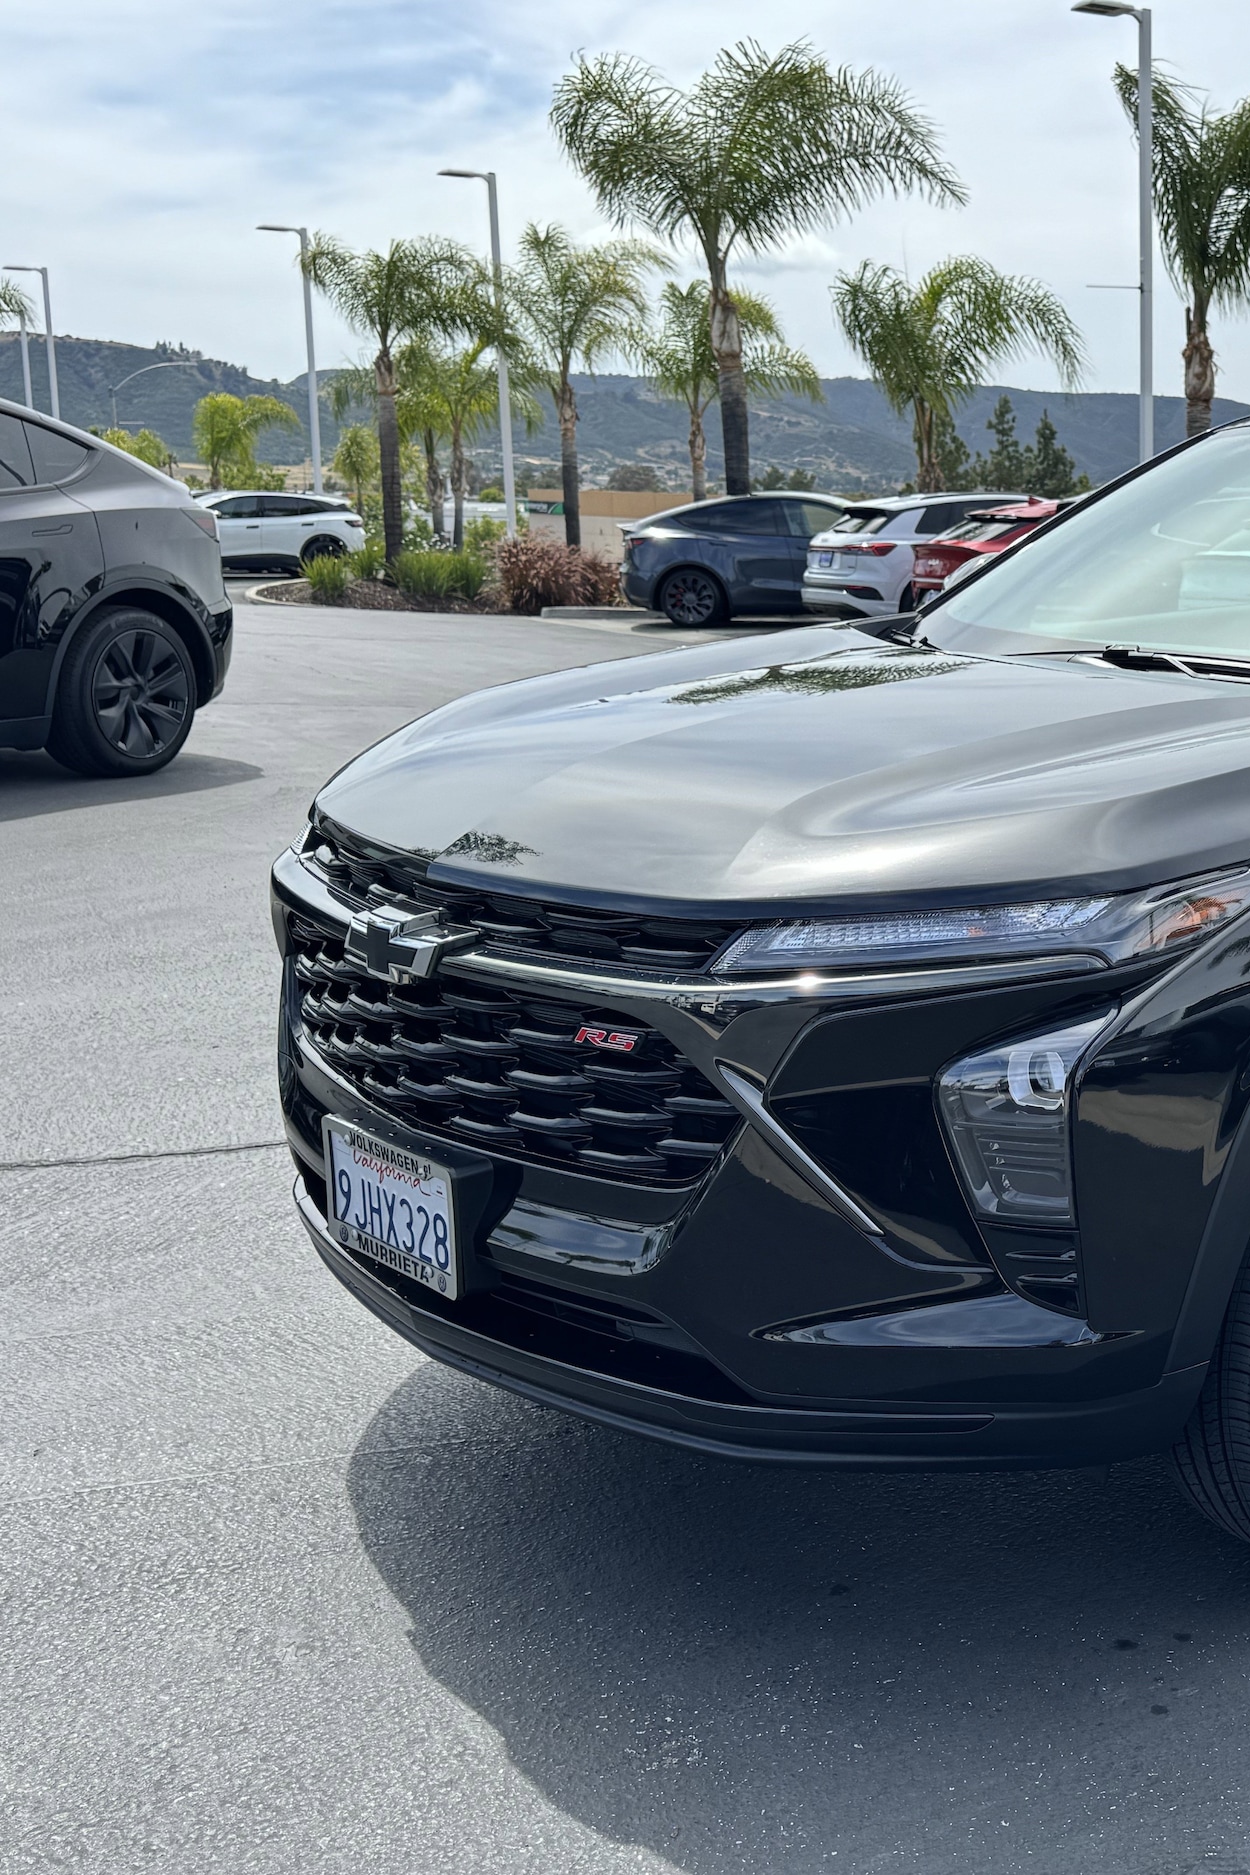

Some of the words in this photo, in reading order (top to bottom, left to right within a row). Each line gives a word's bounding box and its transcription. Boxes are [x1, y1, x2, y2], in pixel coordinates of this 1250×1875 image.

[575, 1027, 638, 1051] RS
[350, 1131, 419, 1174] VOLKSWAGEN
[338, 1168, 450, 1271] 9JHX328
[357, 1233, 430, 1283] MURRIETA
